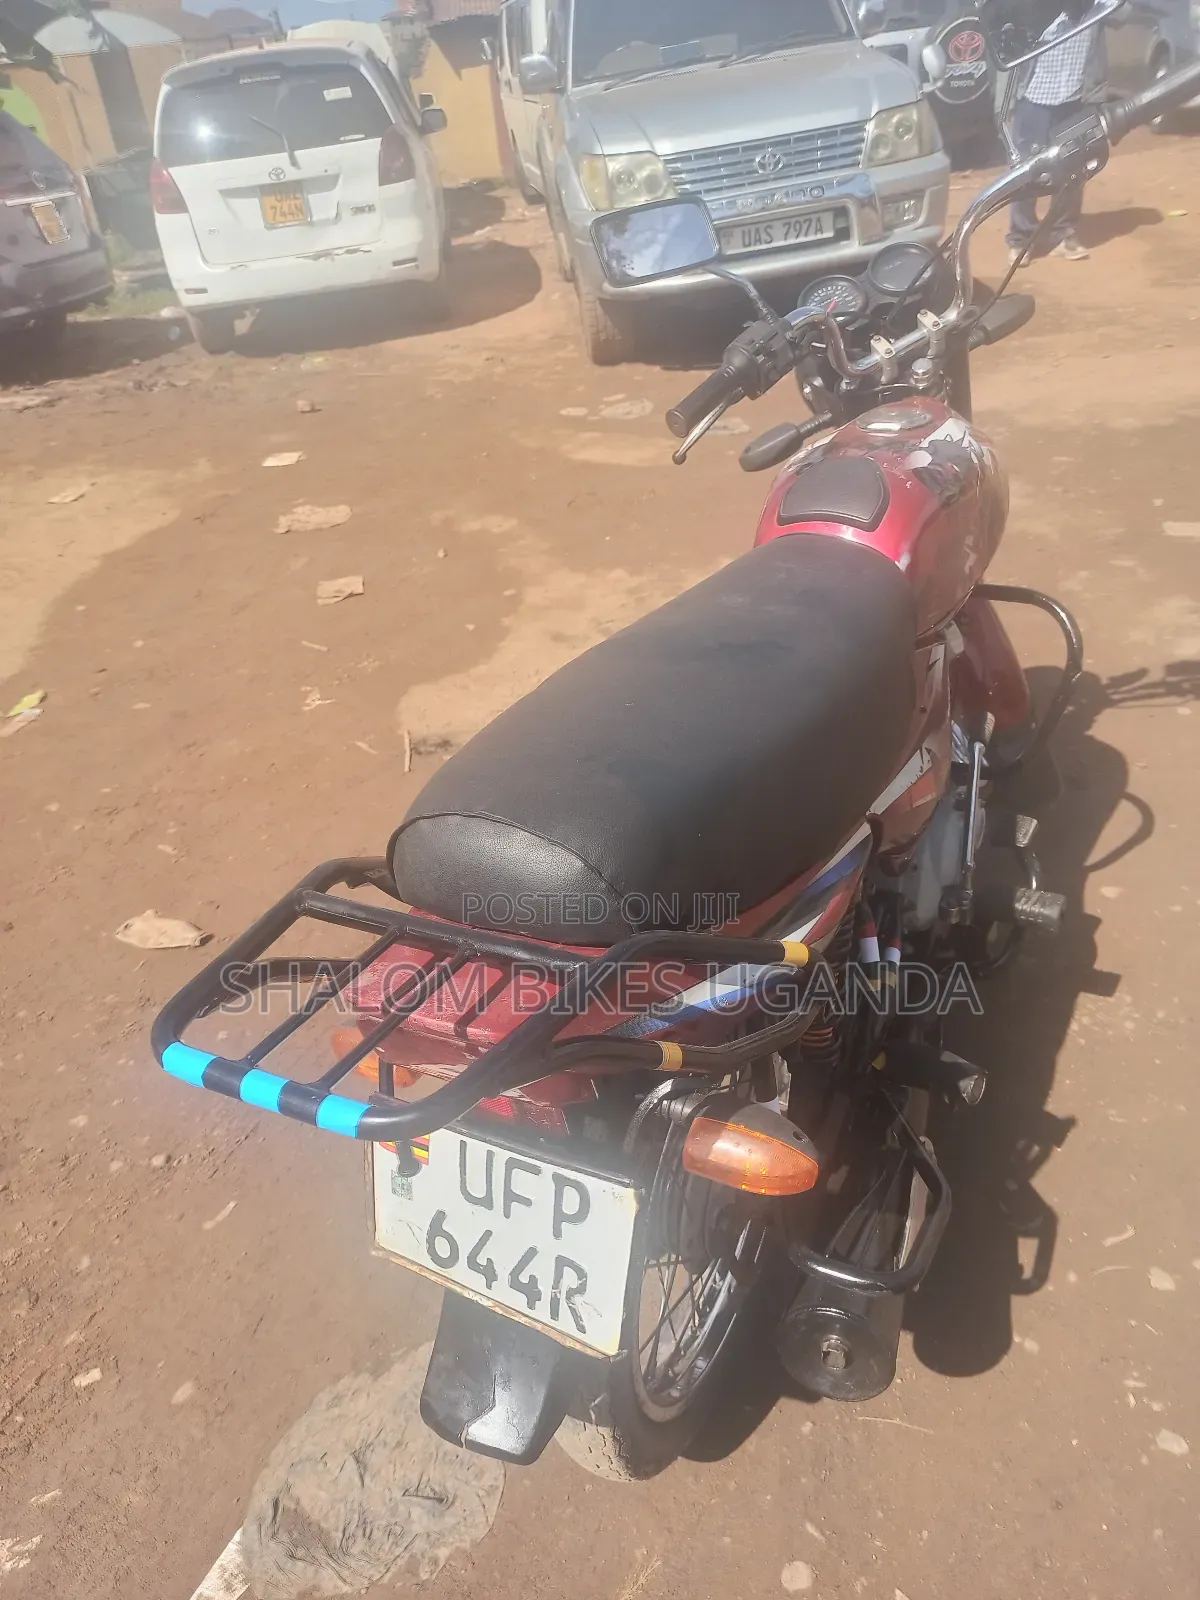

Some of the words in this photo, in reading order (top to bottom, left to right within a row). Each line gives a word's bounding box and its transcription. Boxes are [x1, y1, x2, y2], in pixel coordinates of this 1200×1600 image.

[741, 224, 774, 248] UAS
[782, 217, 824, 239] 797A
[458, 1138, 592, 1241] UFP
[425, 1208, 589, 1335] 644R
